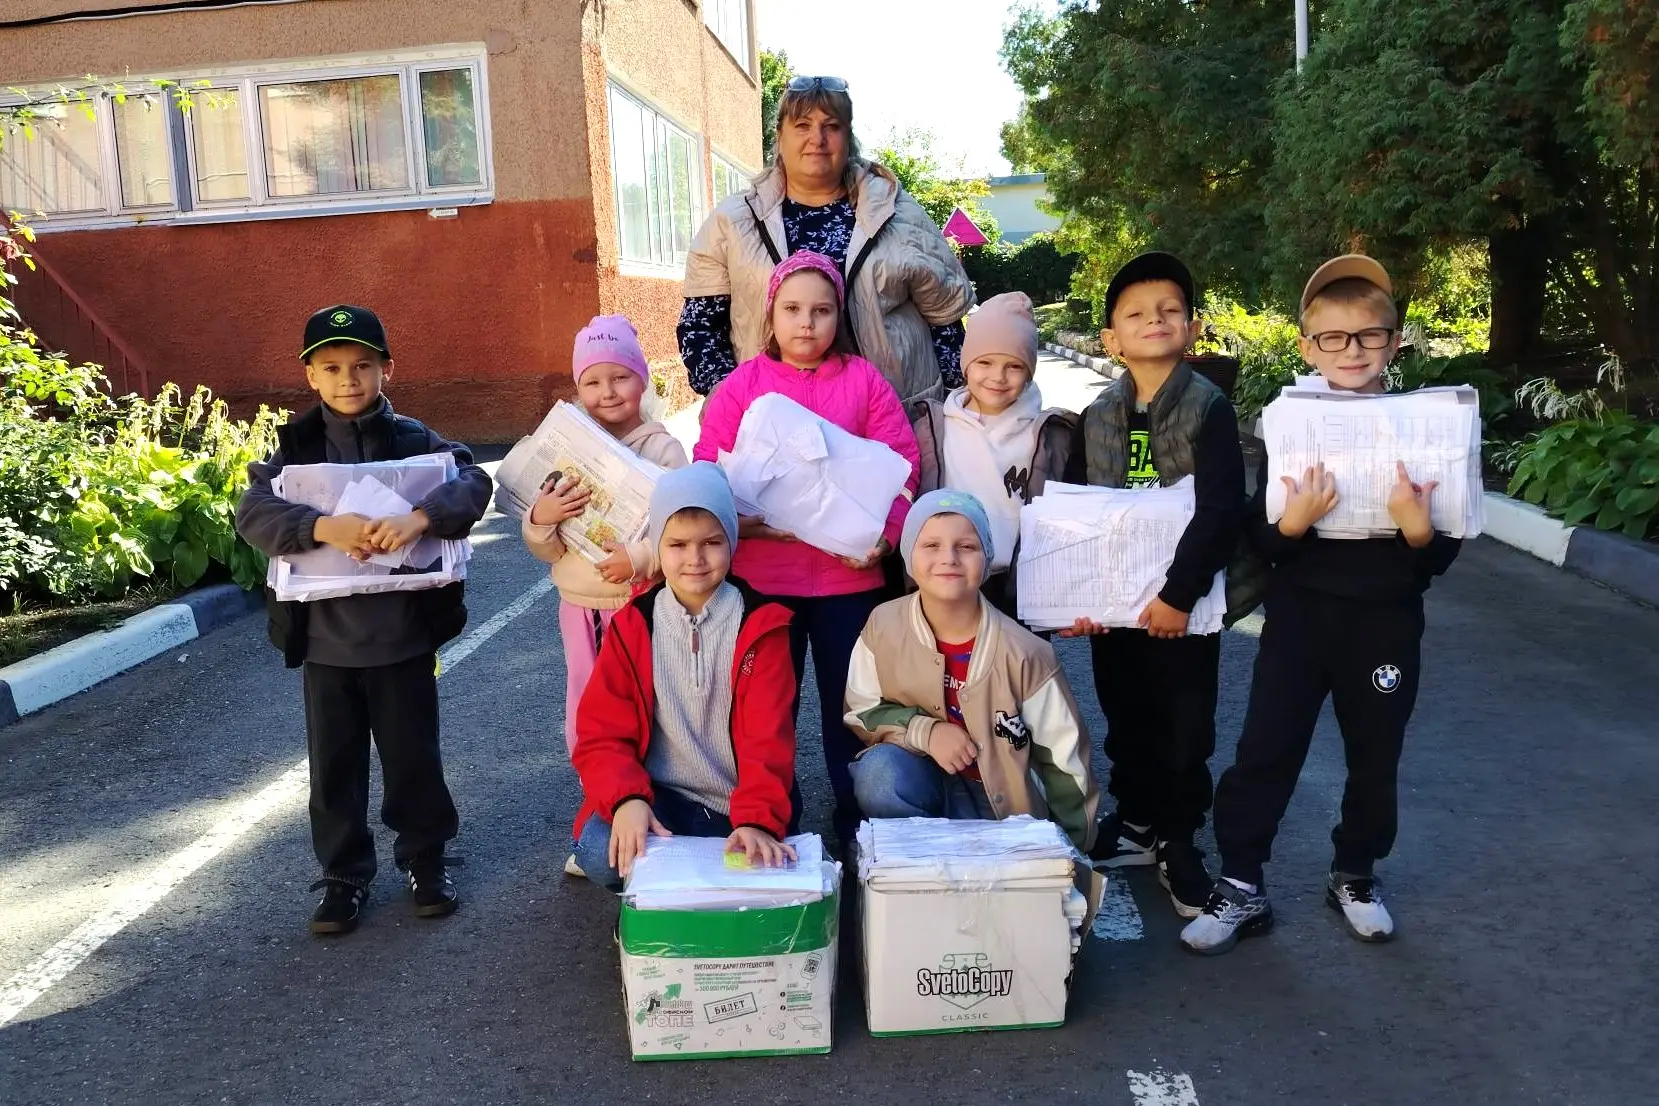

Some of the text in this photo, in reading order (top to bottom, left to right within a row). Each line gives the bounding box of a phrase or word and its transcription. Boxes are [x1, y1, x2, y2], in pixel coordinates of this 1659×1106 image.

[917, 967, 1013, 996] SvetoCopy
[714, 999, 746, 1015] БИЛЕТ
[647, 1015, 694, 1027] ТОПЕ
[942, 1013, 988, 1021] CLASSIC
